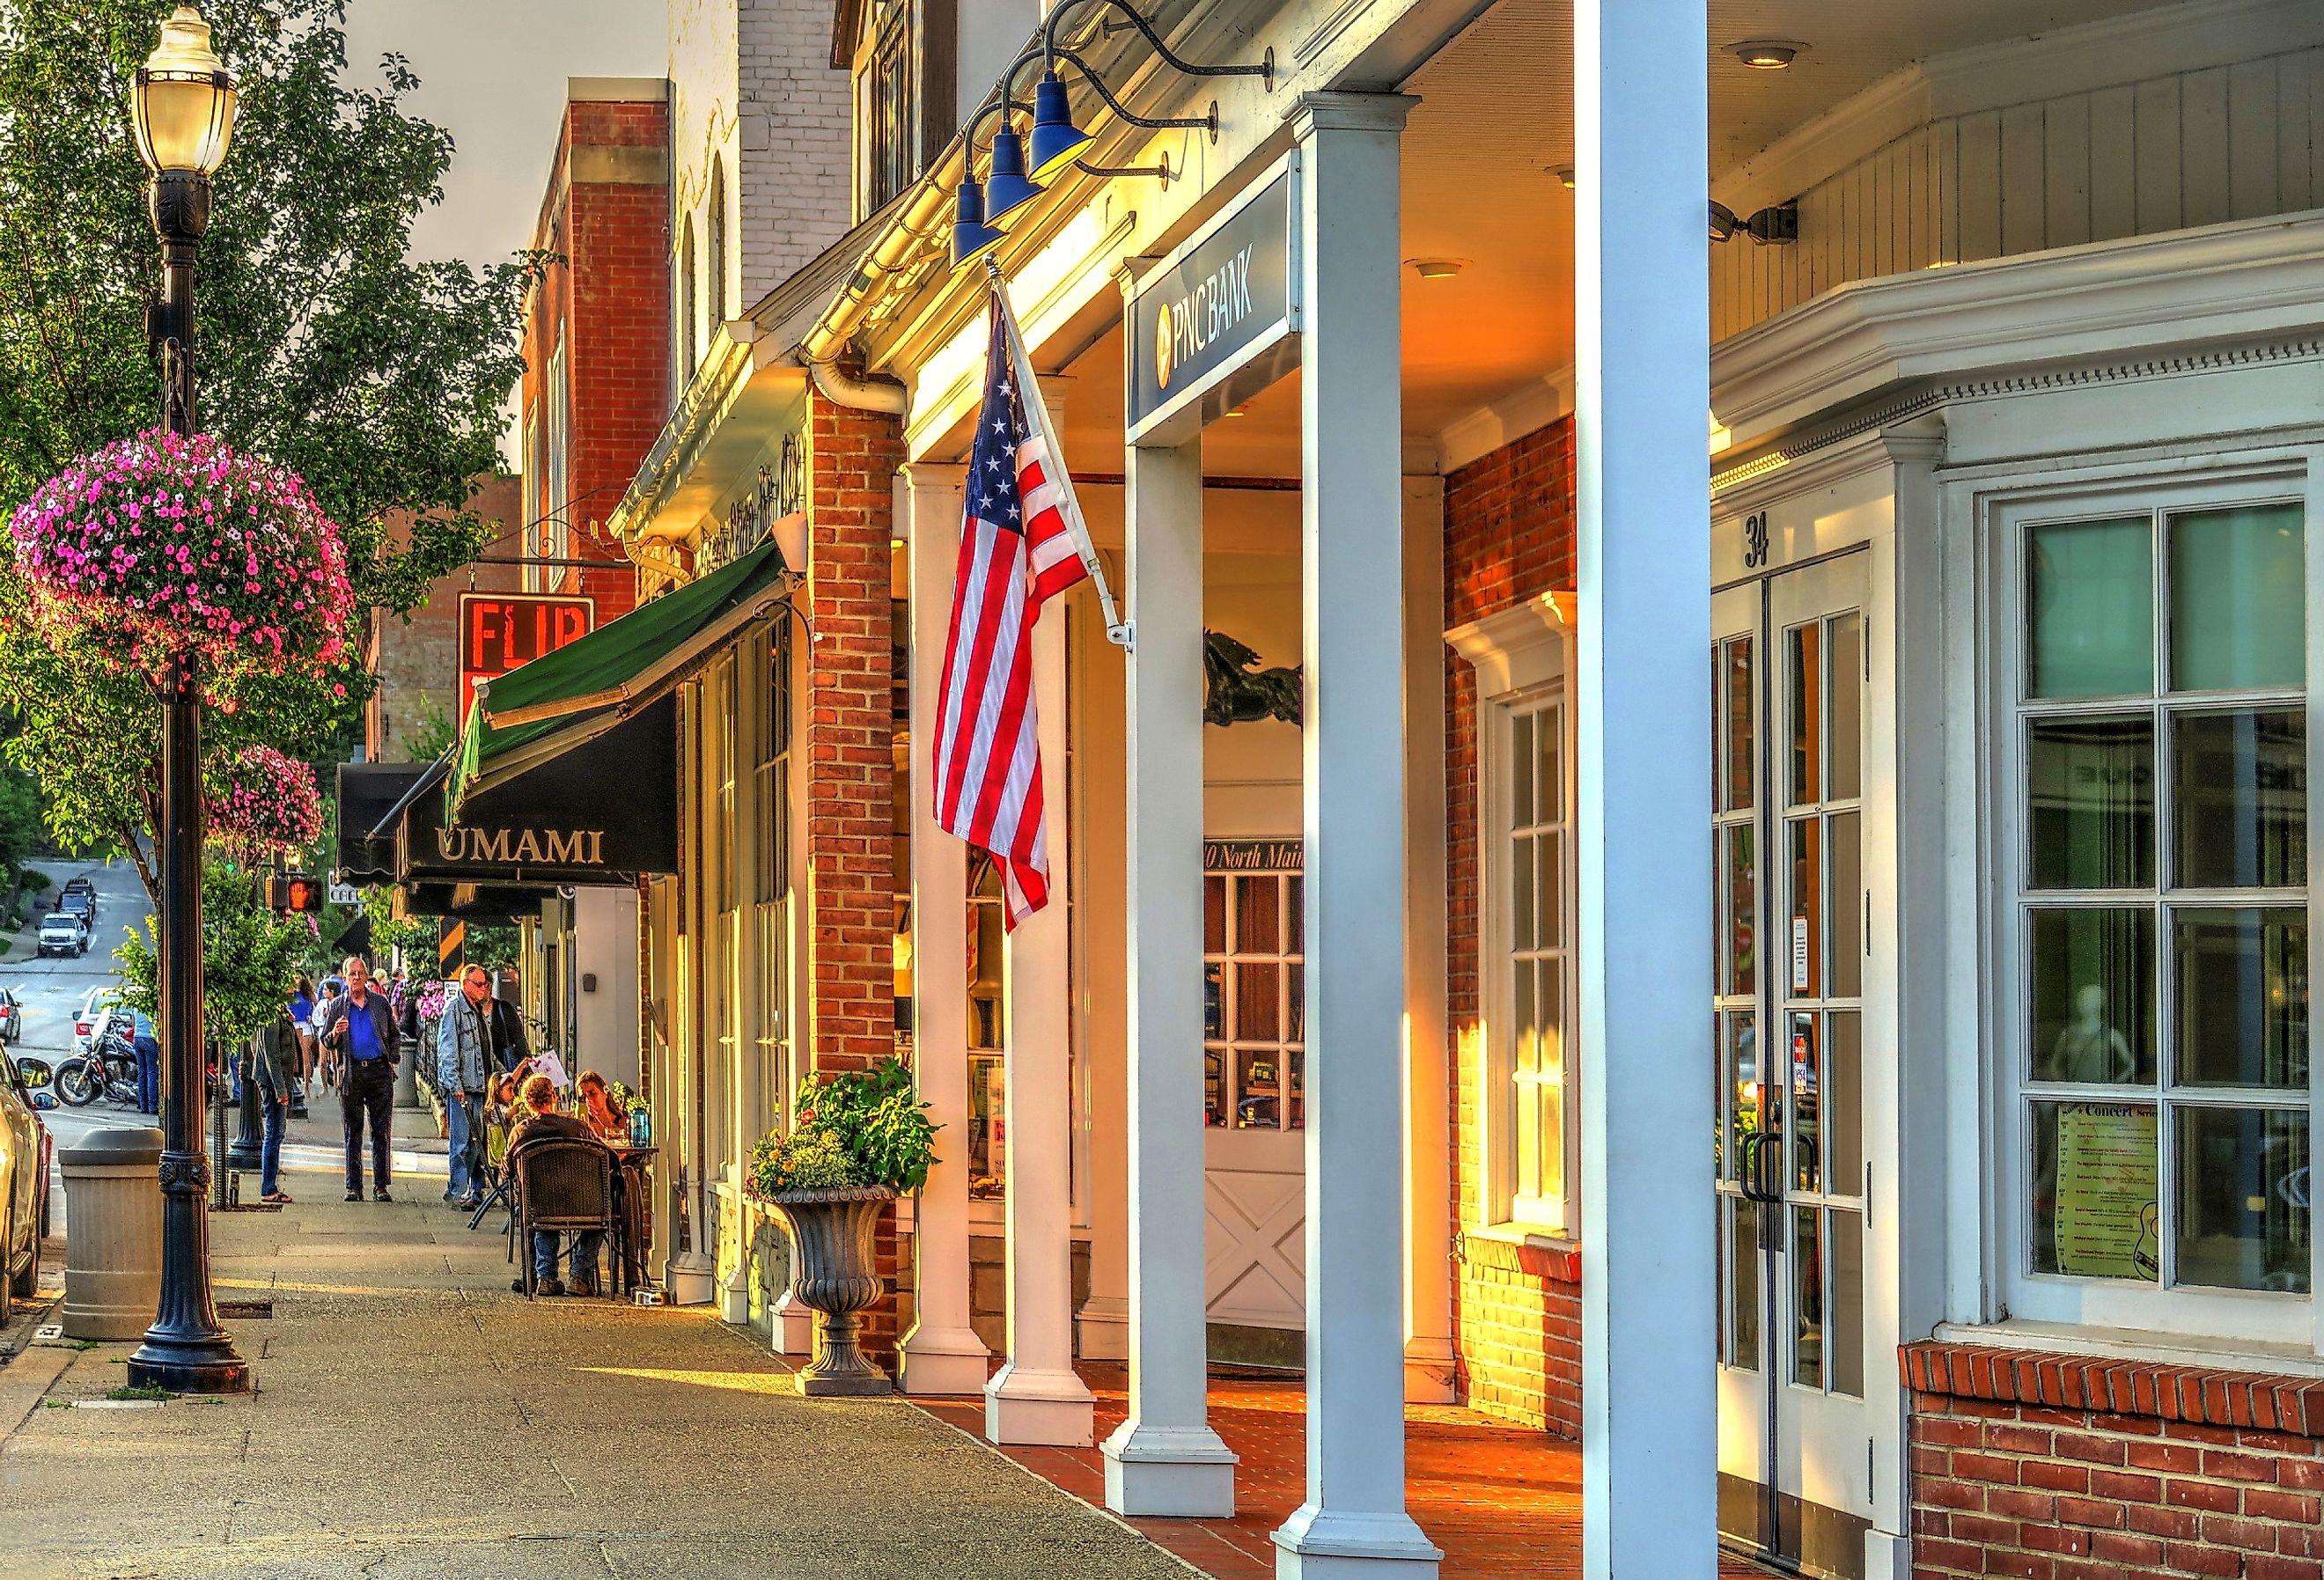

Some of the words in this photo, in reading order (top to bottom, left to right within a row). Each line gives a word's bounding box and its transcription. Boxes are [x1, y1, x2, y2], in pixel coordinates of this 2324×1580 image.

[1745, 511, 1769, 568] 34
[435, 827, 605, 864] UMAMI
[1217, 843, 1261, 869] North
[2085, 1103, 2133, 1119] Concert
